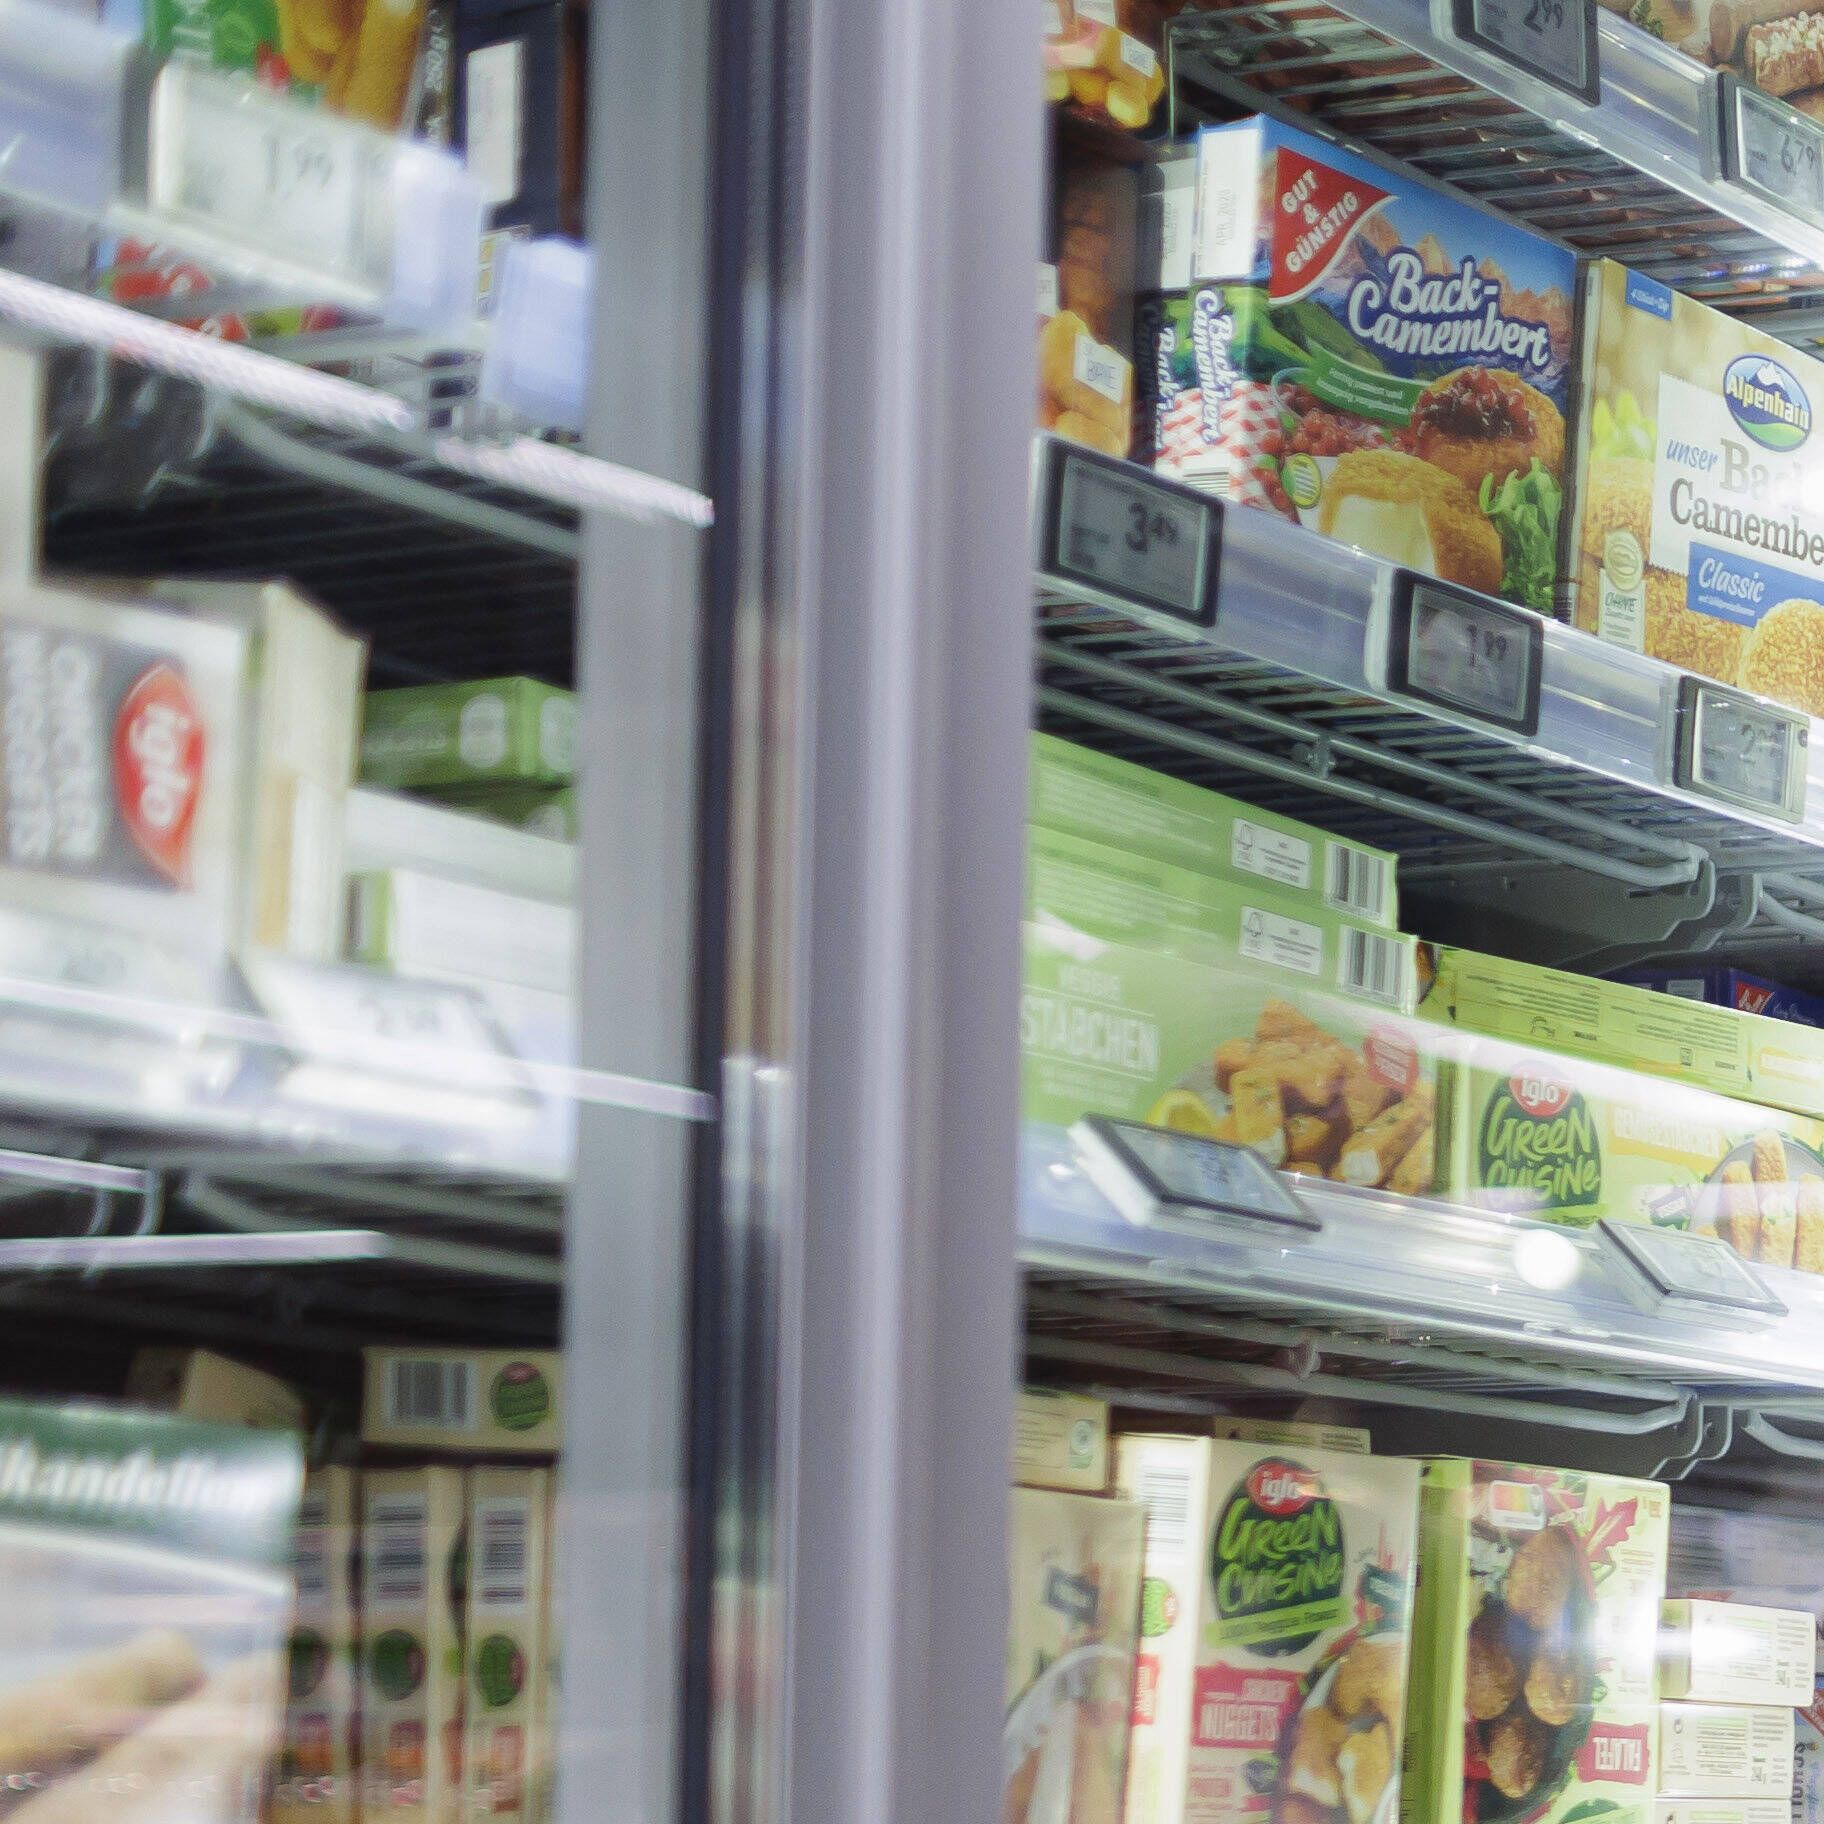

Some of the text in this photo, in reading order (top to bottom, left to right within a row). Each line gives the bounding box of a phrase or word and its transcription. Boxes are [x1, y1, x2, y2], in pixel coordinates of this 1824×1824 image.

[1281, 168, 1319, 214] GUT
[1302, 202, 1321, 225] &
[1285, 190, 1360, 273] GÜNSTIG
[1387, 251, 1499, 314] Back-
[1348, 279, 1549, 367] Camembert
[1193, 289, 1222, 445] Camembert
[1724, 373, 1811, 432] Alpenhain
[1665, 438, 1719, 473] unser
[1698, 555, 1767, 604] Classic
[128, 703, 191, 831] iglo
[1520, 1072, 1560, 1106] iglo
[1593, 1737, 1642, 1772] FALAFEL
